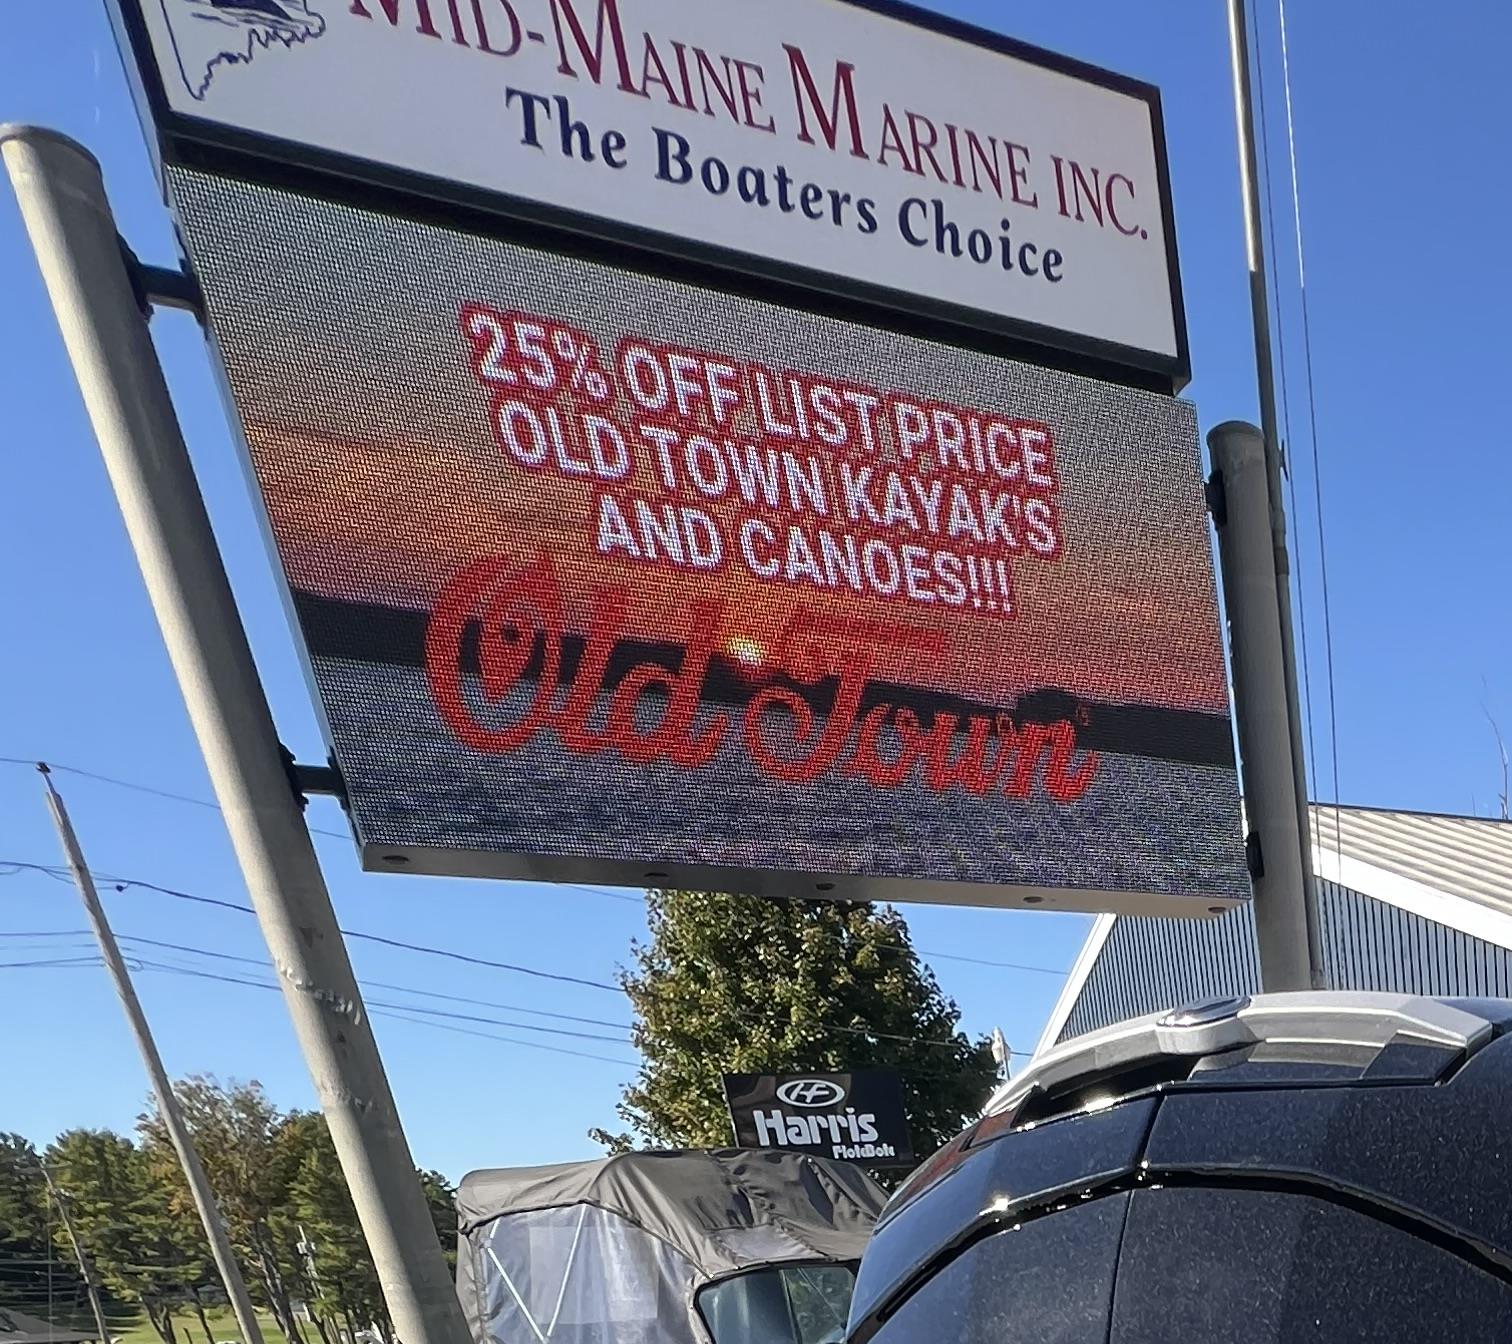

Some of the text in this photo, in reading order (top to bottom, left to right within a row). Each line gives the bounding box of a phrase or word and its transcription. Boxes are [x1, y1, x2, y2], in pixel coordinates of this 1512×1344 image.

[350, 0, 1149, 241] ID-MAINE MARINE INC.
[504, 86, 1064, 283] The Boaters Choice
[469, 312, 1055, 488] 25% OFF LIST PRICE
[499, 400, 1059, 554] OLD TOWN KAYAK'S
[597, 494, 1014, 612] AND CANOES!!!
[425, 552, 1097, 804] Old Town
[752, 1107, 880, 1147] Harris
